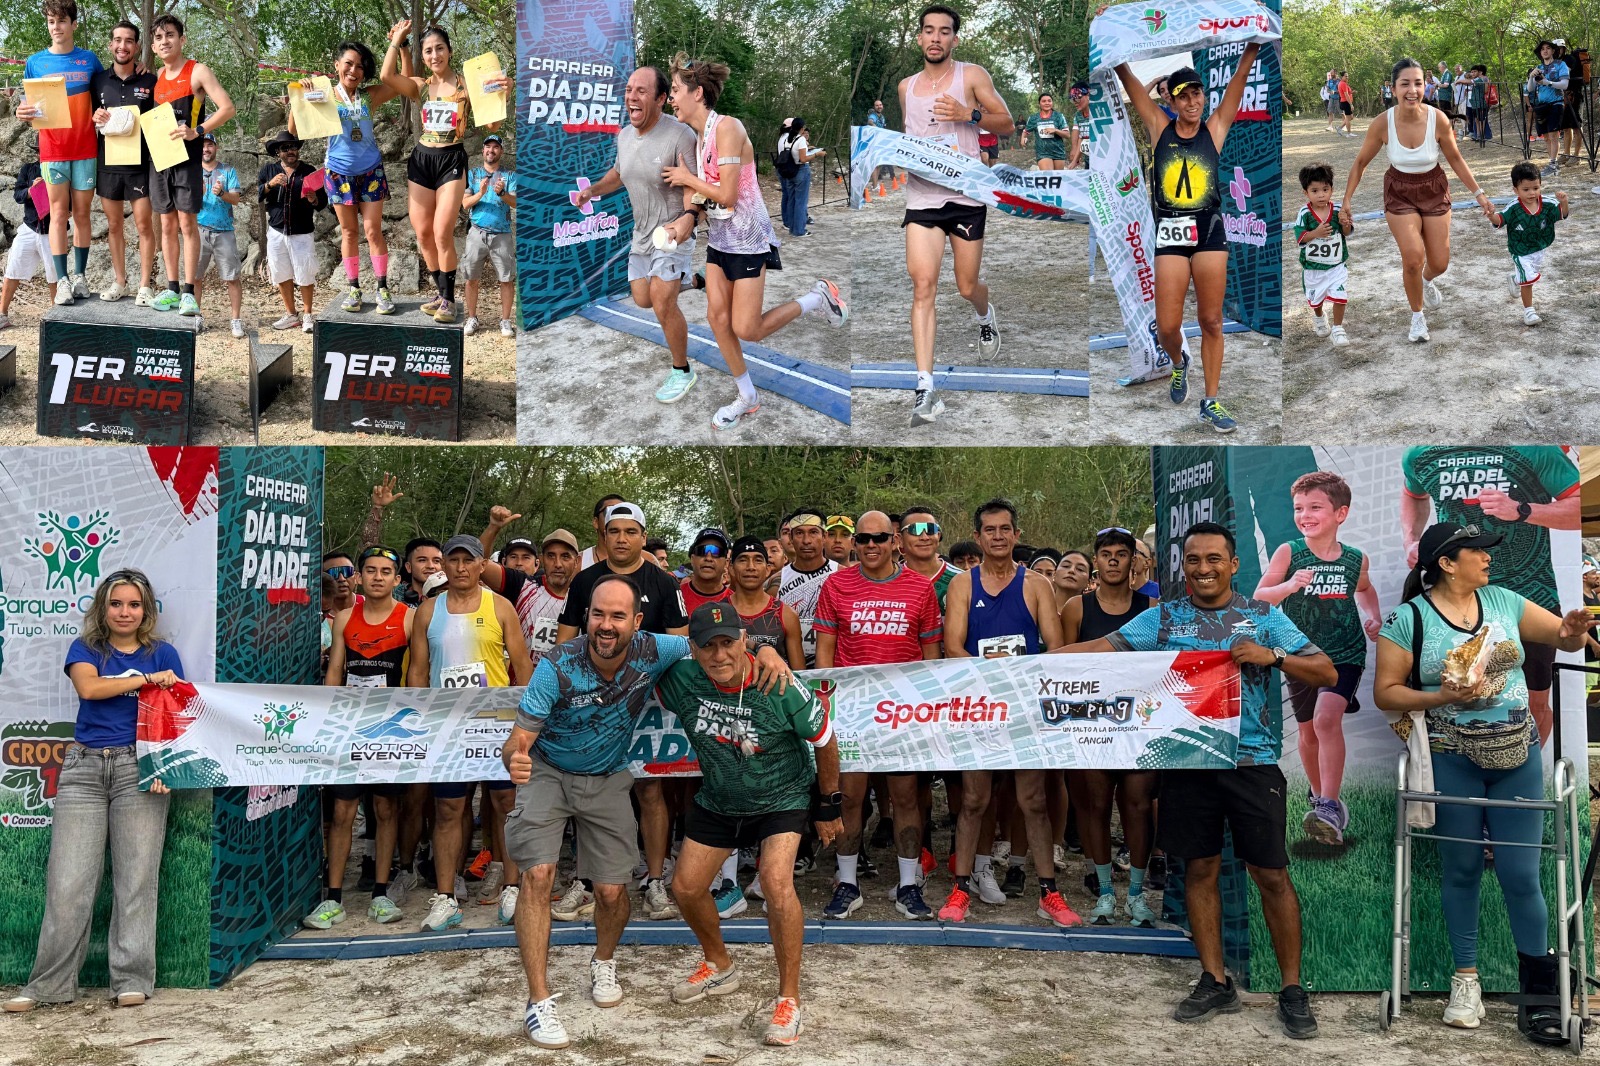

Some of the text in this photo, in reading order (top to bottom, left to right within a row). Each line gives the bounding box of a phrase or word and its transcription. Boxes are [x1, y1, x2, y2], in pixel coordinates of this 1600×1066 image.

[1131, 40, 1167, 49] INSTITUTO
[528, 57, 614, 78] CARRERA
[1209, 60, 1233, 89] DÍA
[528, 73, 618, 102] DÍA DEL
[1209, 84, 1269, 116] PRE
[426, 108, 455, 124] 472
[527, 100, 622, 126] PADRE
[896, 148, 918, 160] DEL
[901, 135, 973, 163] CHEVROLET
[995, 169, 1063, 190] CARRERA
[1099, 171, 1114, 203] INSTITUTO
[1092, 173, 1106, 203] CULTURA
[1088, 182, 1109, 227] DEPORTE
[553, 212, 619, 239] MediFem
[1160, 226, 1193, 242] 360
[1307, 242, 1342, 258] 297
[1126, 220, 1156, 305] Sportlán
[136, 347, 180, 357] CARRERA
[407, 345, 449, 354] CARRERA
[135, 353, 181, 369] DÍA DEL
[406, 351, 450, 365] DÍA DEL
[133, 366, 183, 379] PADRE
[323, 351, 397, 401] 1ER
[404, 363, 452, 375] PADRE
[49, 353, 126, 405] 1ER
[72, 383, 184, 412] LUGAR
[346, 380, 453, 408] LUGAR
[101, 424, 134, 432] MOTION
[1438, 455, 1504, 468] CARRERA
[1169, 460, 1213, 494] CARRERA
[1439, 467, 1508, 485] DÍA DEL
[245, 474, 308, 504] CARRERA
[243, 501, 308, 548] DÍA DEL
[1169, 494, 1190, 539] DÍA
[240, 548, 310, 590] PADRE
[778, 575, 805, 599] ANCUN
[1326, 574, 1347, 584] DEL
[1303, 584, 1349, 596] PADRE
[852, 600, 906, 610] CARRERA
[851, 608, 909, 623] DÍA DEL
[8, 623, 81, 637] Tuyo. Mío.
[535, 627, 558, 646] 45
[850, 622, 910, 636] PADRE
[1038, 678, 1100, 696] XTREME
[873, 695, 1006, 730] Sportlán
[464, 727, 513, 735] CHEVR
[846, 731, 858, 739] LA
[1108, 724, 1139, 733] DIVERSIÓN
[236, 740, 327, 757] Parque Cancún
[350, 741, 428, 752] MOTION
[838, 740, 860, 749] SICA
[1078, 735, 1114, 746] CANCÚN
[8, 742, 76, 765] CROC
[350, 751, 427, 761] EVENTS
[464, 747, 491, 759] DEL
[11, 815, 46, 825] Conoce
